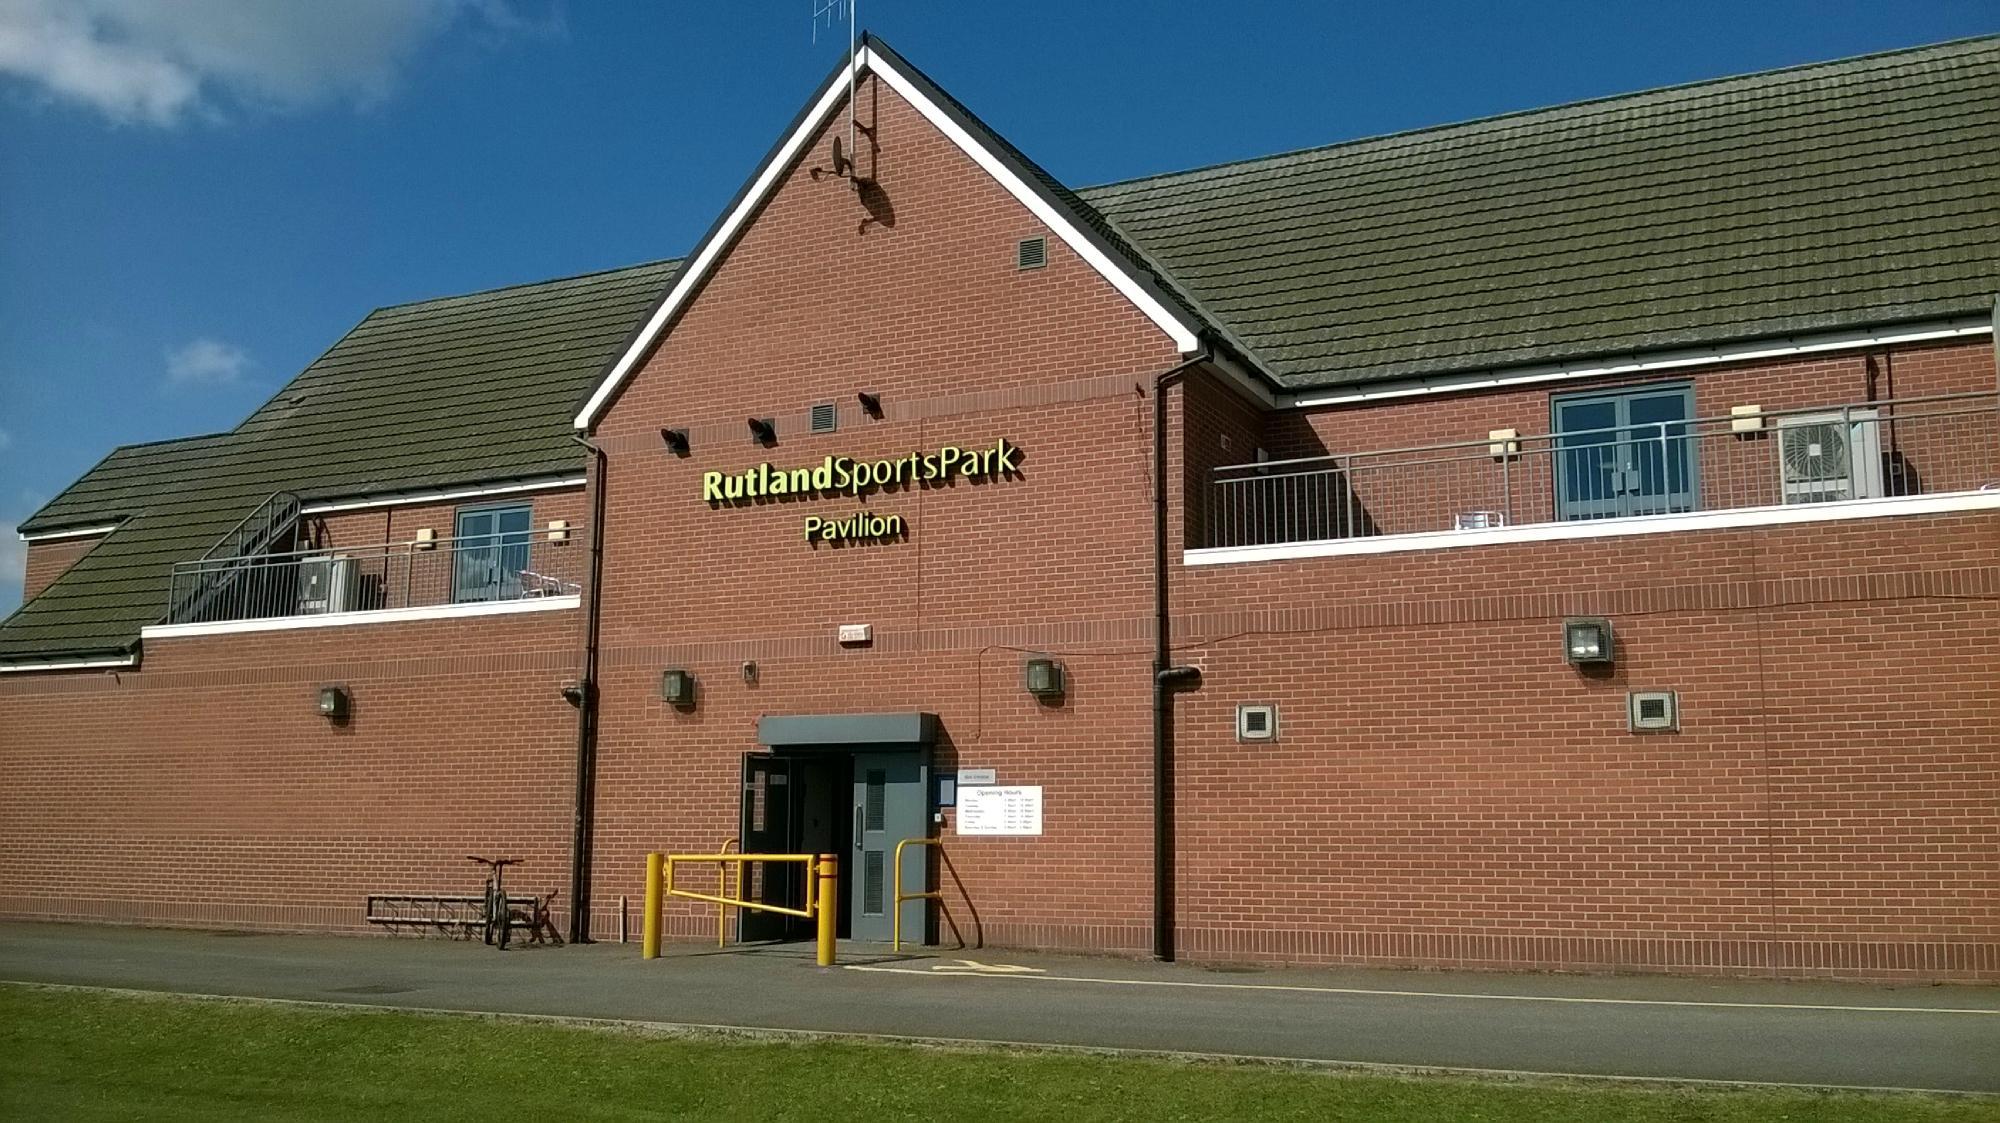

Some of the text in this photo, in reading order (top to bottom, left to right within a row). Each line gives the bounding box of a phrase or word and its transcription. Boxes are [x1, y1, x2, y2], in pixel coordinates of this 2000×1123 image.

[703, 438, 1017, 501] RutlandSportsPark
[804, 511, 901, 541] Pavilion
[976, 789, 1002, 797] Opening
